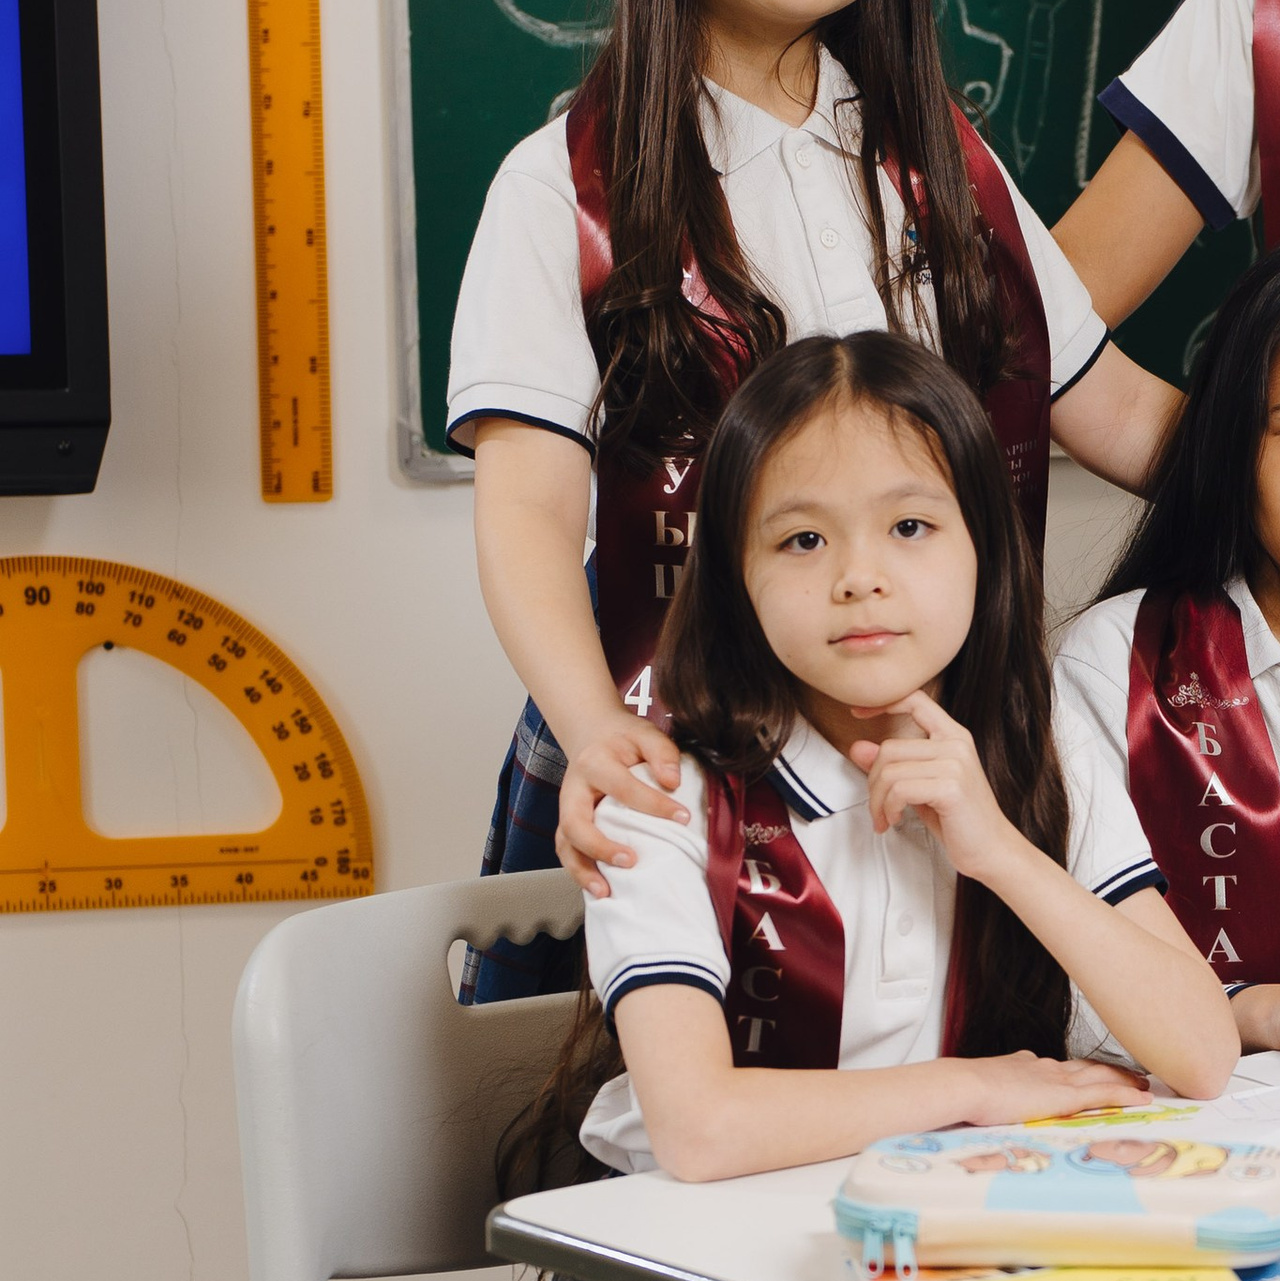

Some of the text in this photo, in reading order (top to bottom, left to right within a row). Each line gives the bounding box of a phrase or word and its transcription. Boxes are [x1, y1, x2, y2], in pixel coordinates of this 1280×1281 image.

[24, 586, 51, 606] 90
[77, 581, 105, 596] 100
[75, 602, 95, 616] 80
[128, 590, 155, 610] 110
[123, 611, 143, 628] 70
[177, 609, 204, 631] 120
[167, 629, 187, 647] 60
[220, 635, 246, 660] 130
[207, 653, 227, 673] 50
[258, 669, 283, 695] 140
[624, 664, 653, 717] 4
[243, 685, 262, 704] 40
[272, 722, 290, 741] 30
[293, 763, 310, 782] 20
[314, 752, 334, 780] 160
[309, 807, 323, 826] 10
[330, 798, 347, 827] 170
[1191, 720, 1246, 984] БАСТА
[38, 866, 370, 894] 25 30 35 40 45 50
